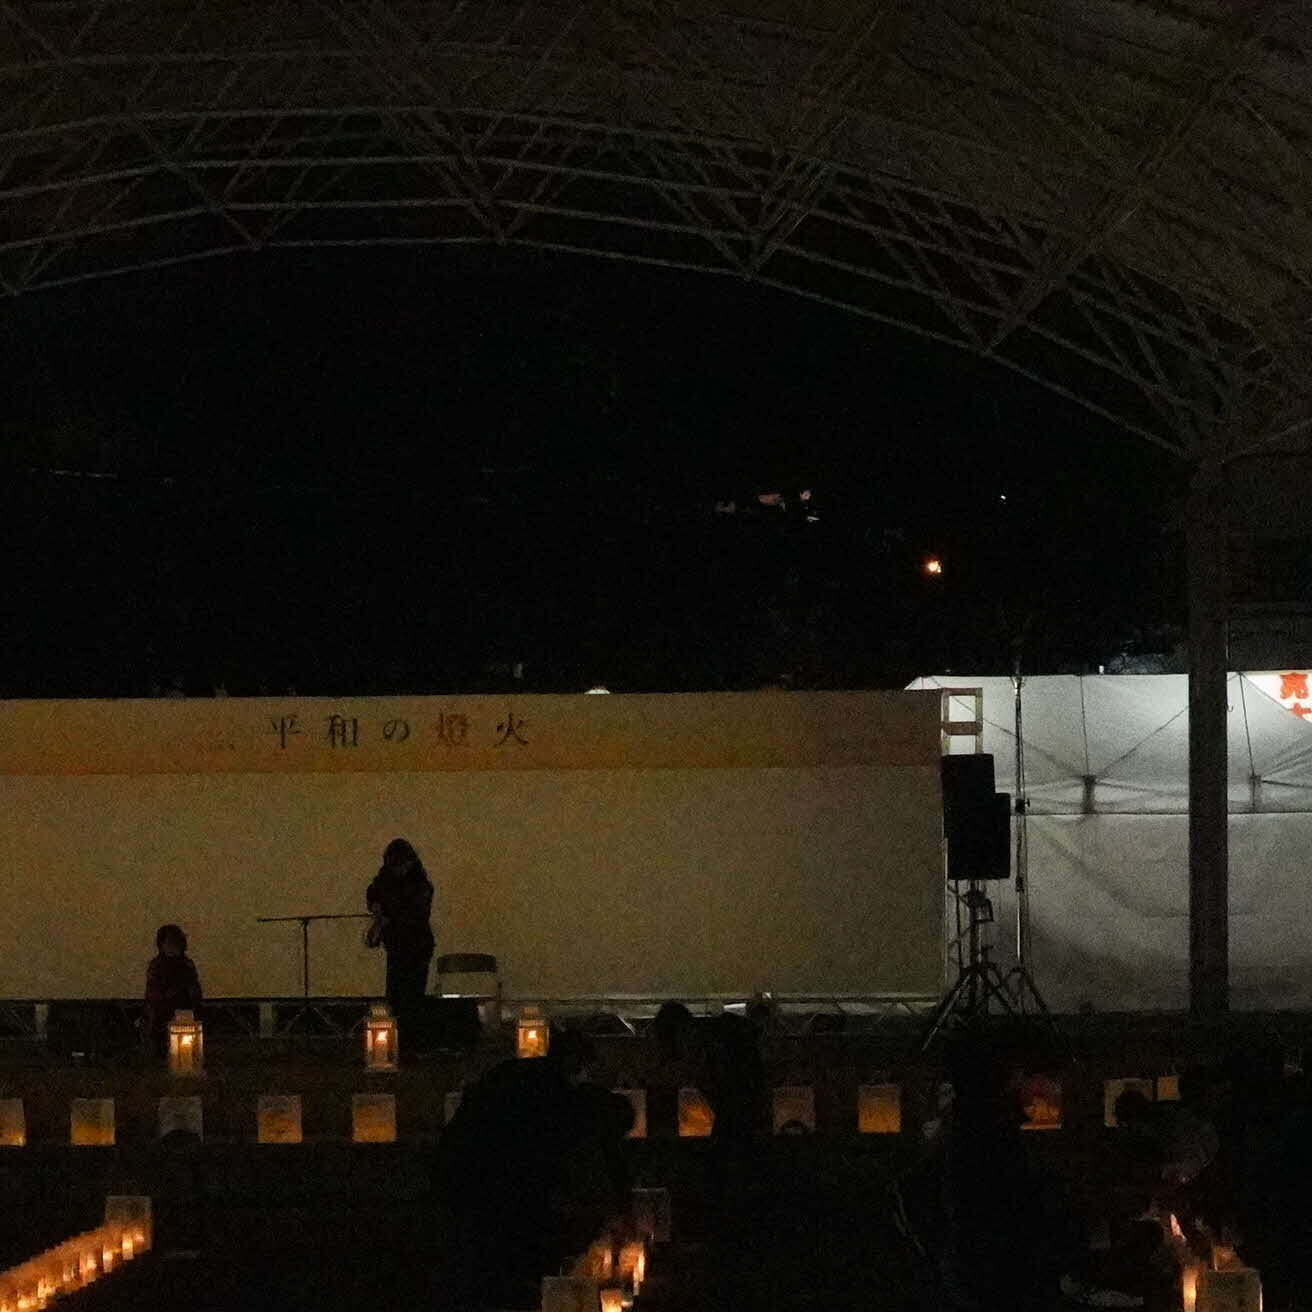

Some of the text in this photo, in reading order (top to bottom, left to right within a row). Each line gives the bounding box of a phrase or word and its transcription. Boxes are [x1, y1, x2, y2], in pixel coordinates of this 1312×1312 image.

[271, 712, 529, 749] 平和の燈火
